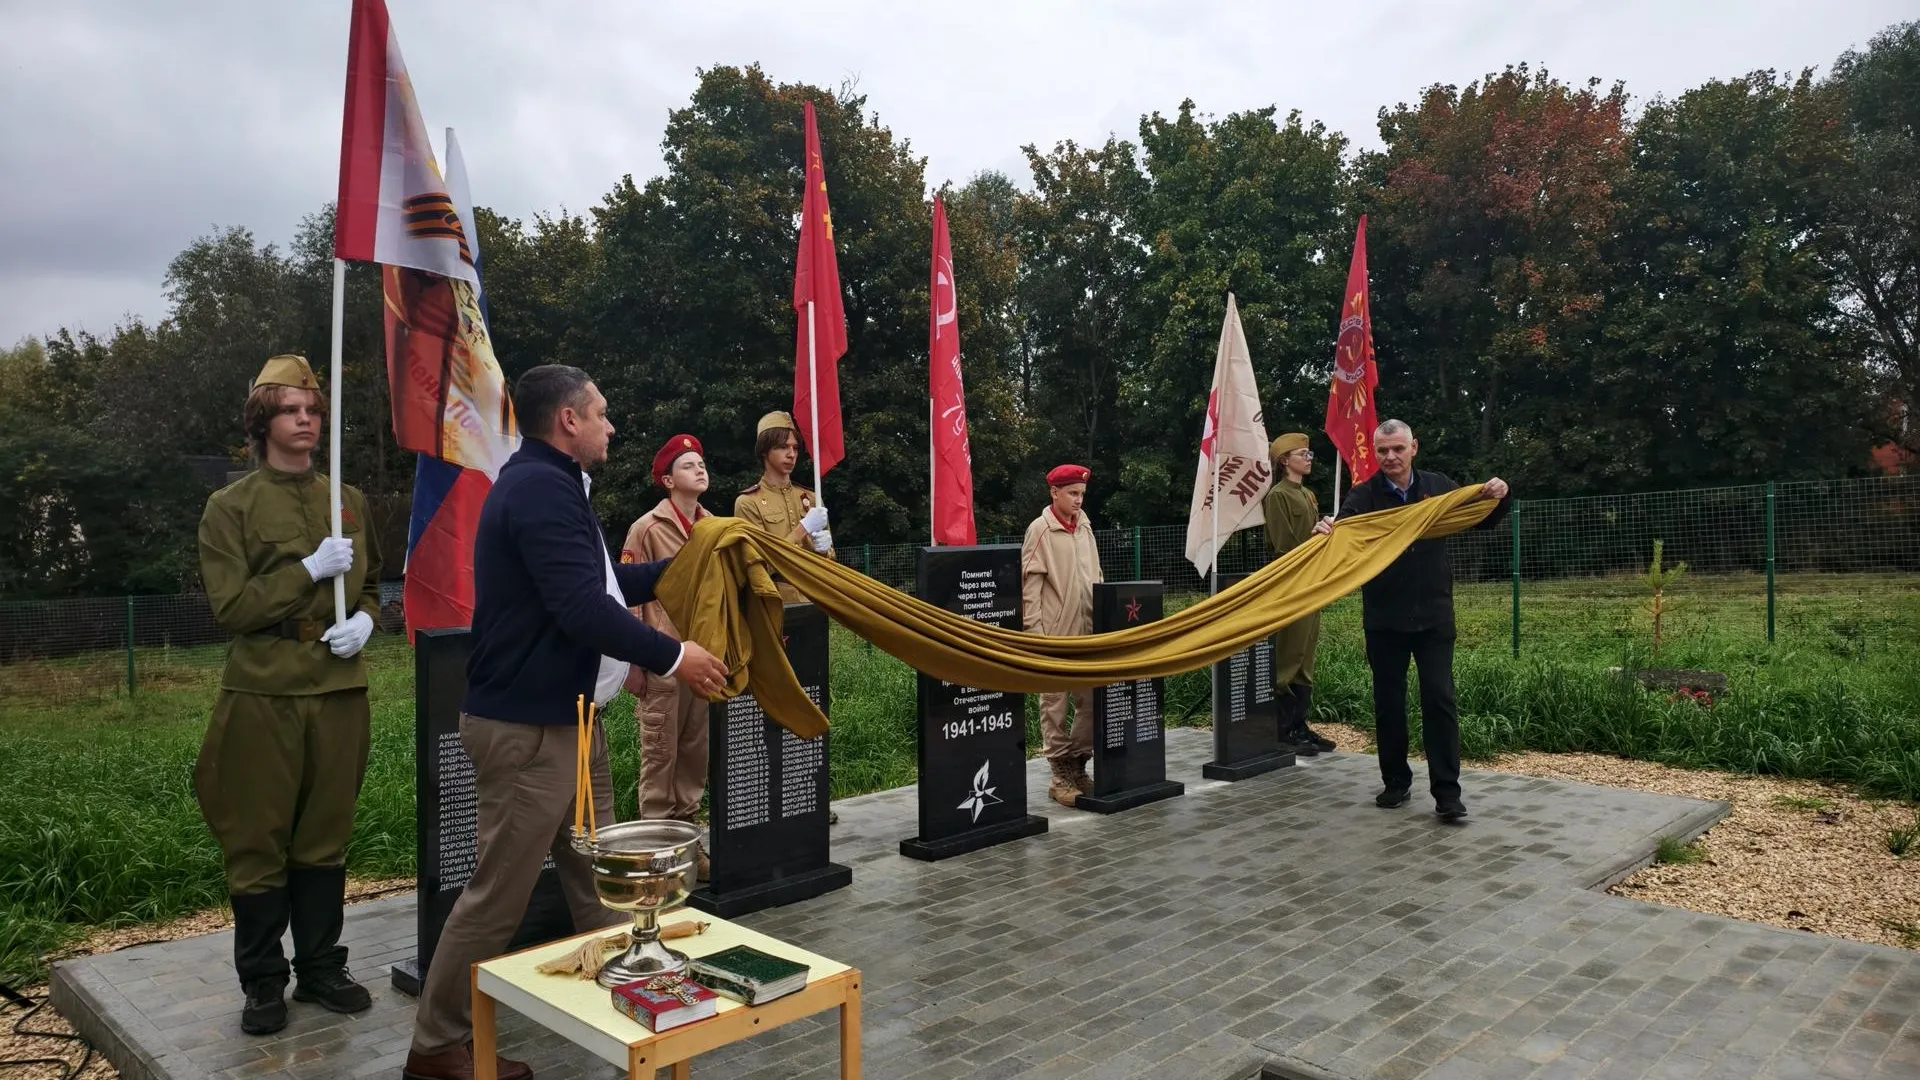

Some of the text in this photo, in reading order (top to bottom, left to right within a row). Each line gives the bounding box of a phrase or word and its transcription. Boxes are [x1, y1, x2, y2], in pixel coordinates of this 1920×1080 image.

[961, 569, 993, 579] Помните!
[959, 581, 979, 590] Через
[957, 591, 996, 601] через года-
[963, 600, 994, 610] помните!
[976, 608, 1016, 619] бессмертен!
[728, 707, 753, 716] ЗАХАРОВ
[968, 704, 990, 714] войне
[728, 714, 753, 723] ЗАХАРОВ
[728, 721, 753, 729] ЗАХАРОВ
[942, 711, 1013, 740] 1941-1945
[728, 727, 753, 736] ЗАХАРОВ
[728, 734, 753, 743] ЗАХАРОВ
[728, 741, 753, 749] ЗАХАРОВ
[440, 857, 465, 867] ГОРИН
[440, 863, 469, 875] ГРАЧЕВ
